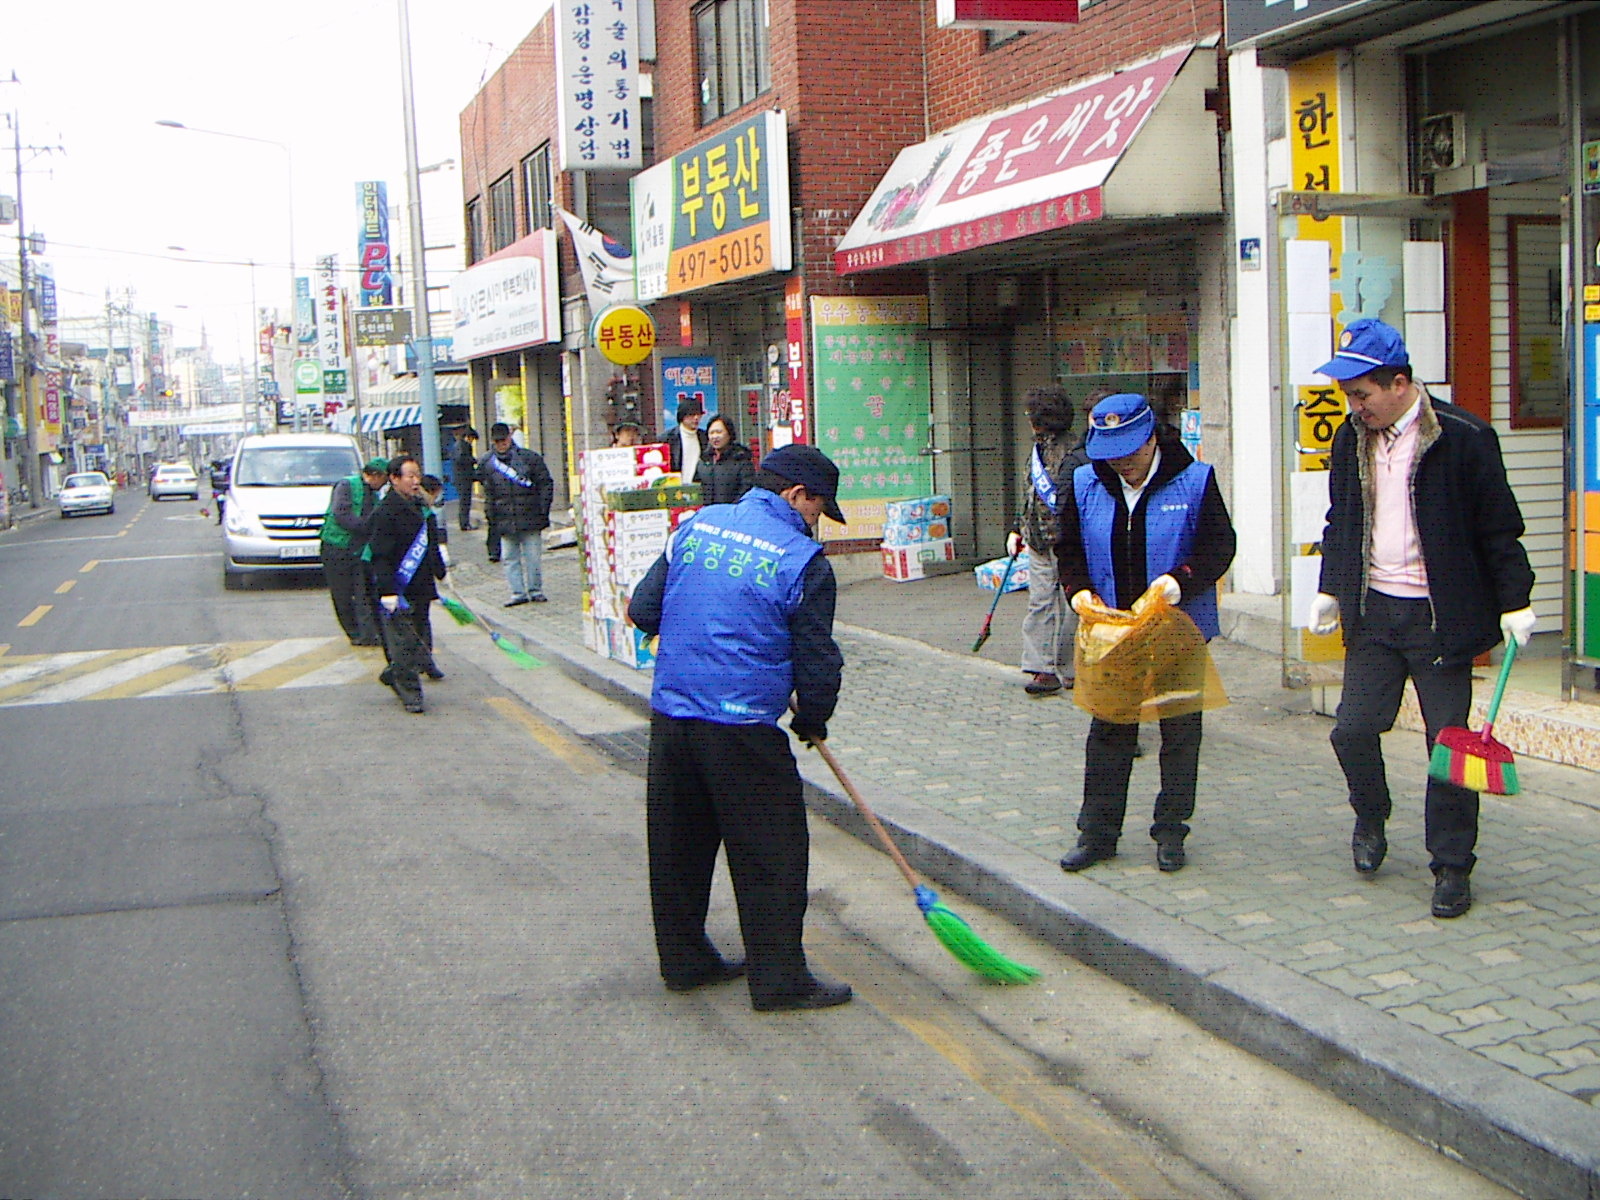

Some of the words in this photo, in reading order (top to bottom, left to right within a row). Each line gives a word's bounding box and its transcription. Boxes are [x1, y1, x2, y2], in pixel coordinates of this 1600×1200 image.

[681, 126, 760, 237] 부동산
[678, 233, 764, 284] 497-5015
[820, 303, 850, 325] 우수
[600, 323, 653, 350] 부동산
[864, 394, 886, 418] 꿀
[681, 534, 779, 588] 청정광진
